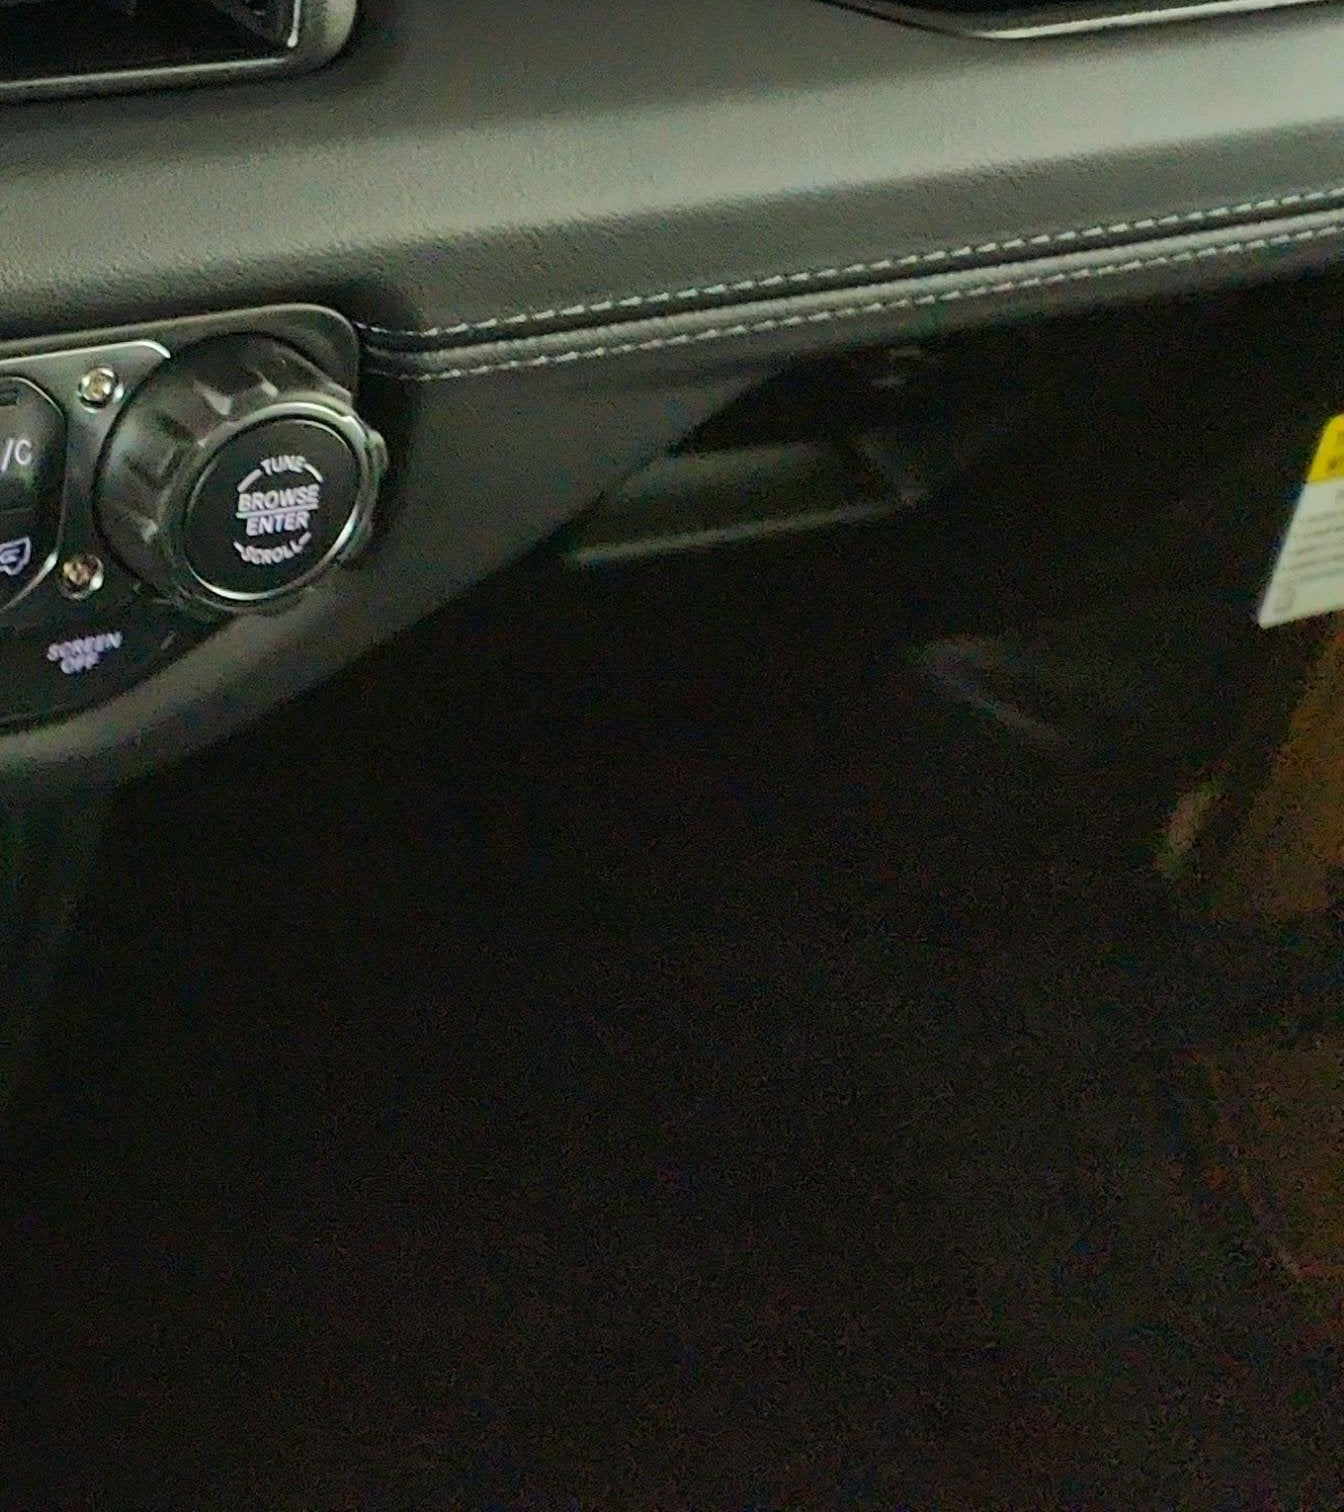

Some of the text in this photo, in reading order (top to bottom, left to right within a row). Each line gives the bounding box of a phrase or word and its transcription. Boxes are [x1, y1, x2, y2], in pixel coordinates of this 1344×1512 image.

[261, 455, 308, 476] TUNE
[237, 483, 320, 512] BROWSE
[246, 510, 310, 536] ENTER
[240, 538, 303, 565] SCROLL
